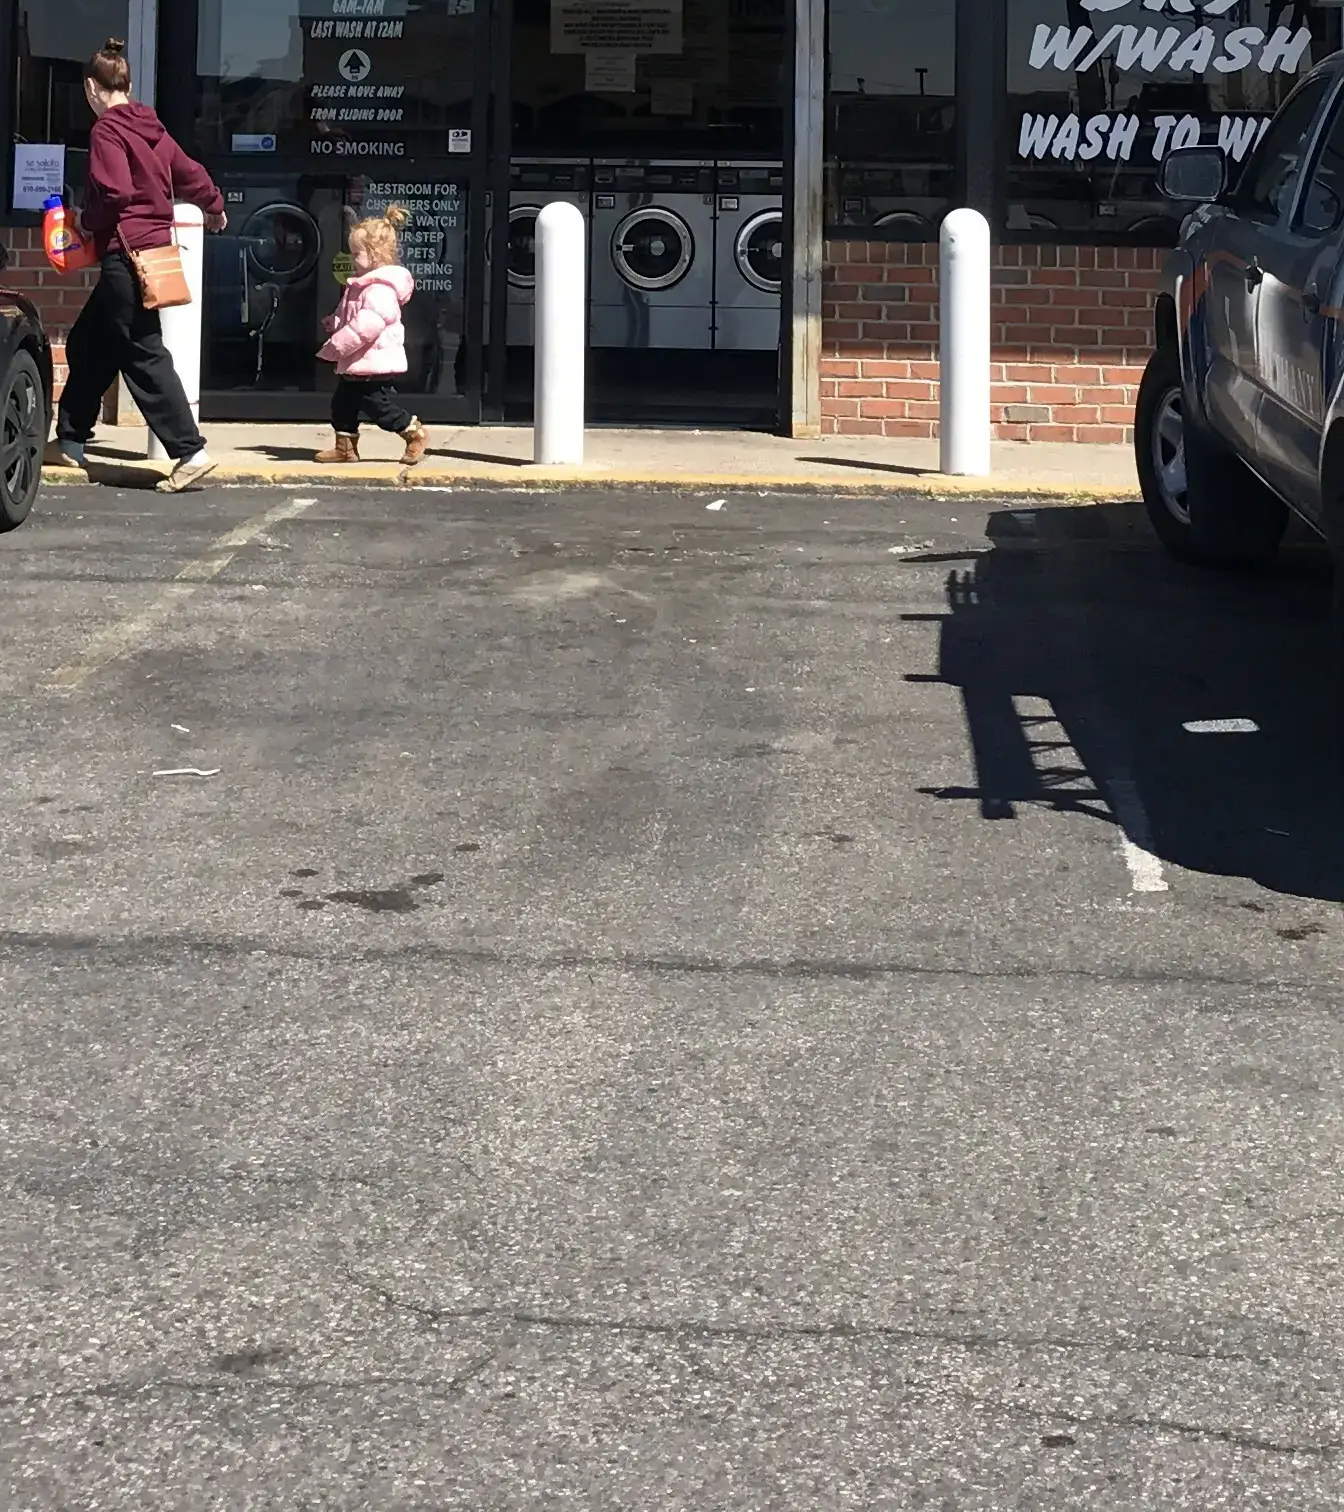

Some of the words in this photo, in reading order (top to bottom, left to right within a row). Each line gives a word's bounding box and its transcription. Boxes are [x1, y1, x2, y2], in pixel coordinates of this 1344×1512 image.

[310, 20, 335, 38] LAST
[335, 20, 363, 38] WASH
[364, 20, 377, 38] AT
[378, 21, 404, 39] 12AM
[1027, 23, 1313, 75] W/WASH
[310, 85, 347, 98] PLEASE
[347, 85, 374, 98] MOVE
[377, 85, 404, 98] AWAY
[310, 107, 337, 121] FROM
[338, 108, 375, 121] SLIDING
[377, 108, 404, 121] DOOR
[1018, 112, 1140, 161] WASH
[1151, 114, 1201, 161] TO
[310, 141, 333, 154] NO
[336, 141, 405, 156] SMOKING
[369, 183, 432, 195] RESTROOM
[434, 184, 457, 196] FOR
[433, 200, 460, 211] ONLY
[416, 215, 457, 227] WATCH
[415, 232, 445, 243] STEP
[407, 248, 436, 259] PETS
[408, 263, 453, 275] TERING
[415, 279, 452, 291] CITING
